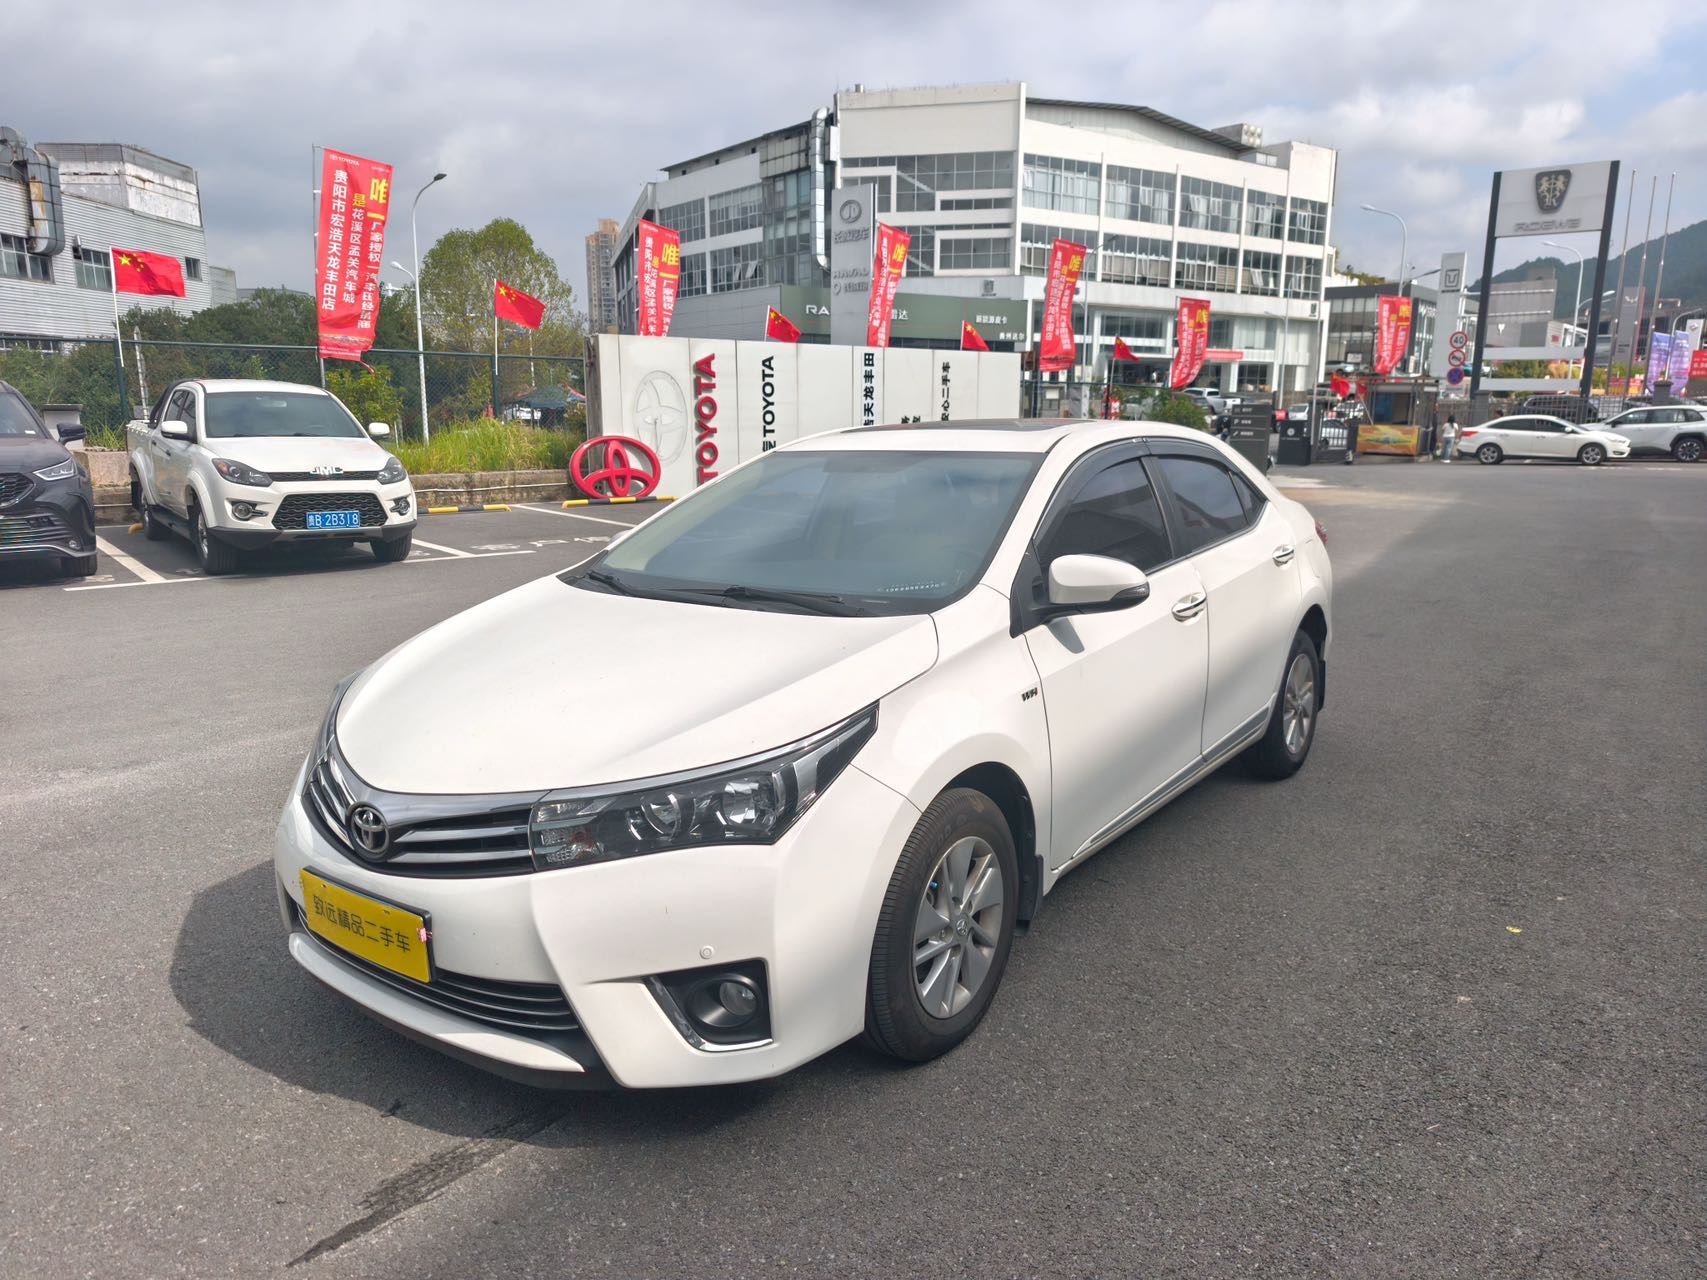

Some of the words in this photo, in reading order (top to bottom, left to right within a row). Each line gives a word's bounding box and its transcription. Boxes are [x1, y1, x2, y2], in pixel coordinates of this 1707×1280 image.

[322, 169, 348, 311] 贵阳市宏浩天龙丰田店
[1453, 335, 1464, 344] 40
[694, 353, 719, 486] TOYOTA
[313, 895, 412, 953] 致远精品二手车
